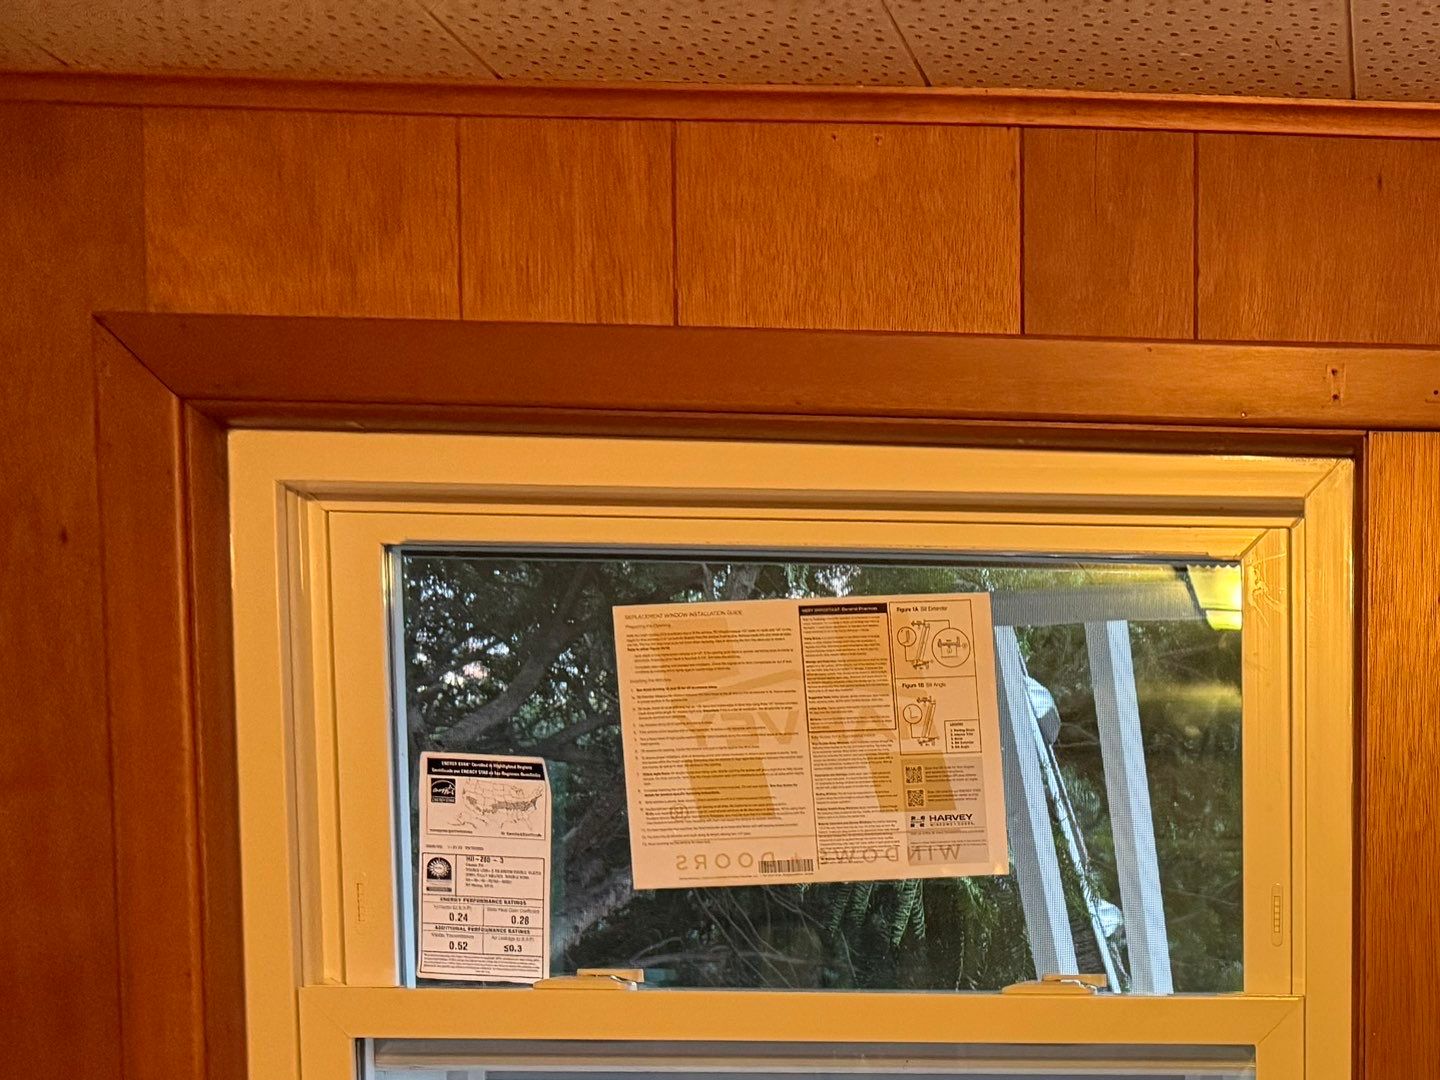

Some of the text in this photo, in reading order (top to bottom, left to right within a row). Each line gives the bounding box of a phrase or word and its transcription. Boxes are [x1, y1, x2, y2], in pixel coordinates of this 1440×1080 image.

[929, 814, 973, 822] HARVEY
[449, 912, 468, 922] 0.24
[449, 940, 468, 951] 0.52
